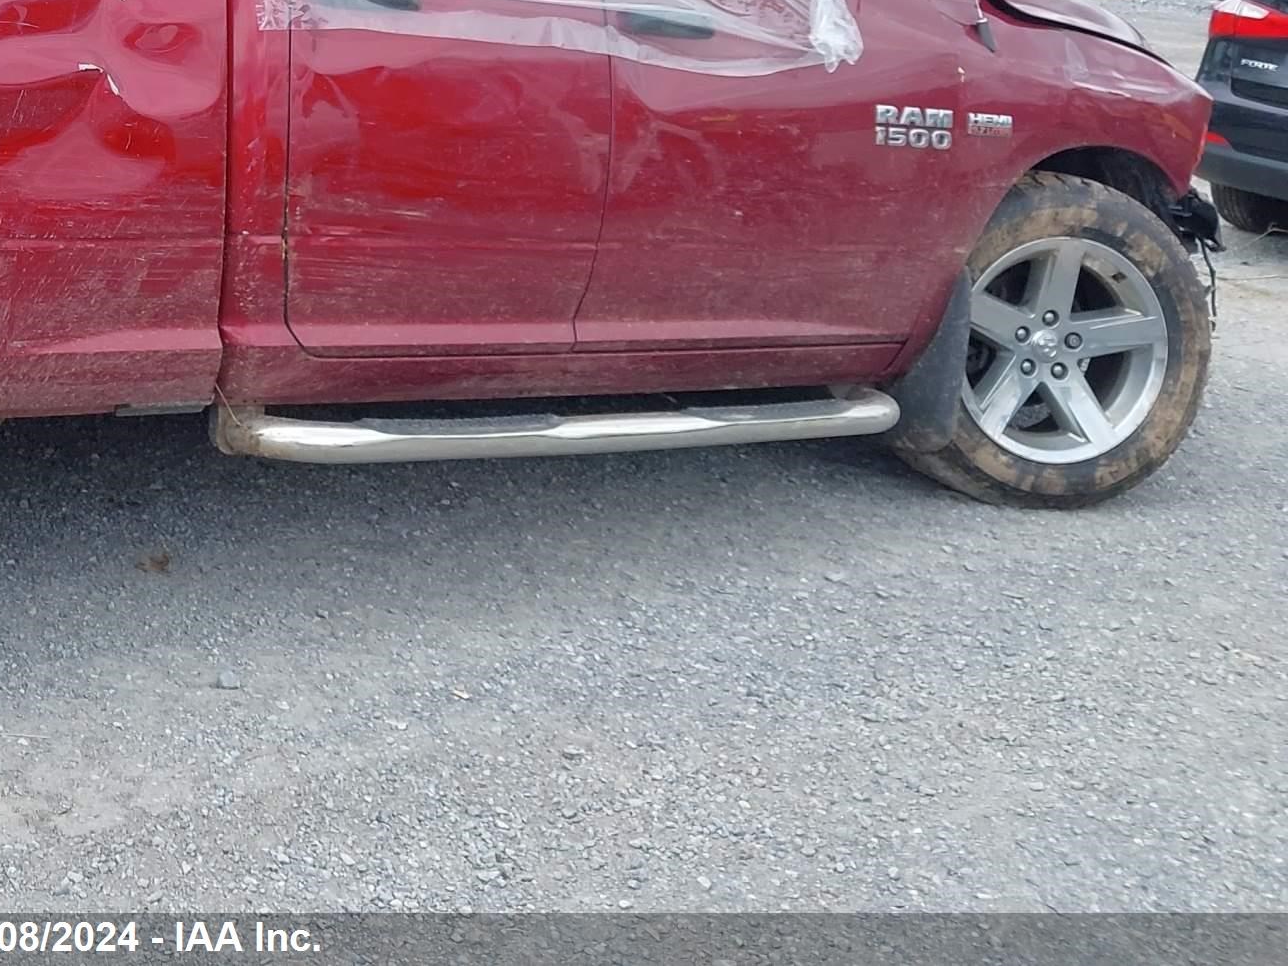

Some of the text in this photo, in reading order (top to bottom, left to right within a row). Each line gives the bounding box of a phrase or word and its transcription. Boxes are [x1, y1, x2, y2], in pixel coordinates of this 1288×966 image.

[1241, 58, 1279, 72] FORTE
[875, 105, 953, 128] RAM
[875, 127, 952, 149] 1500
